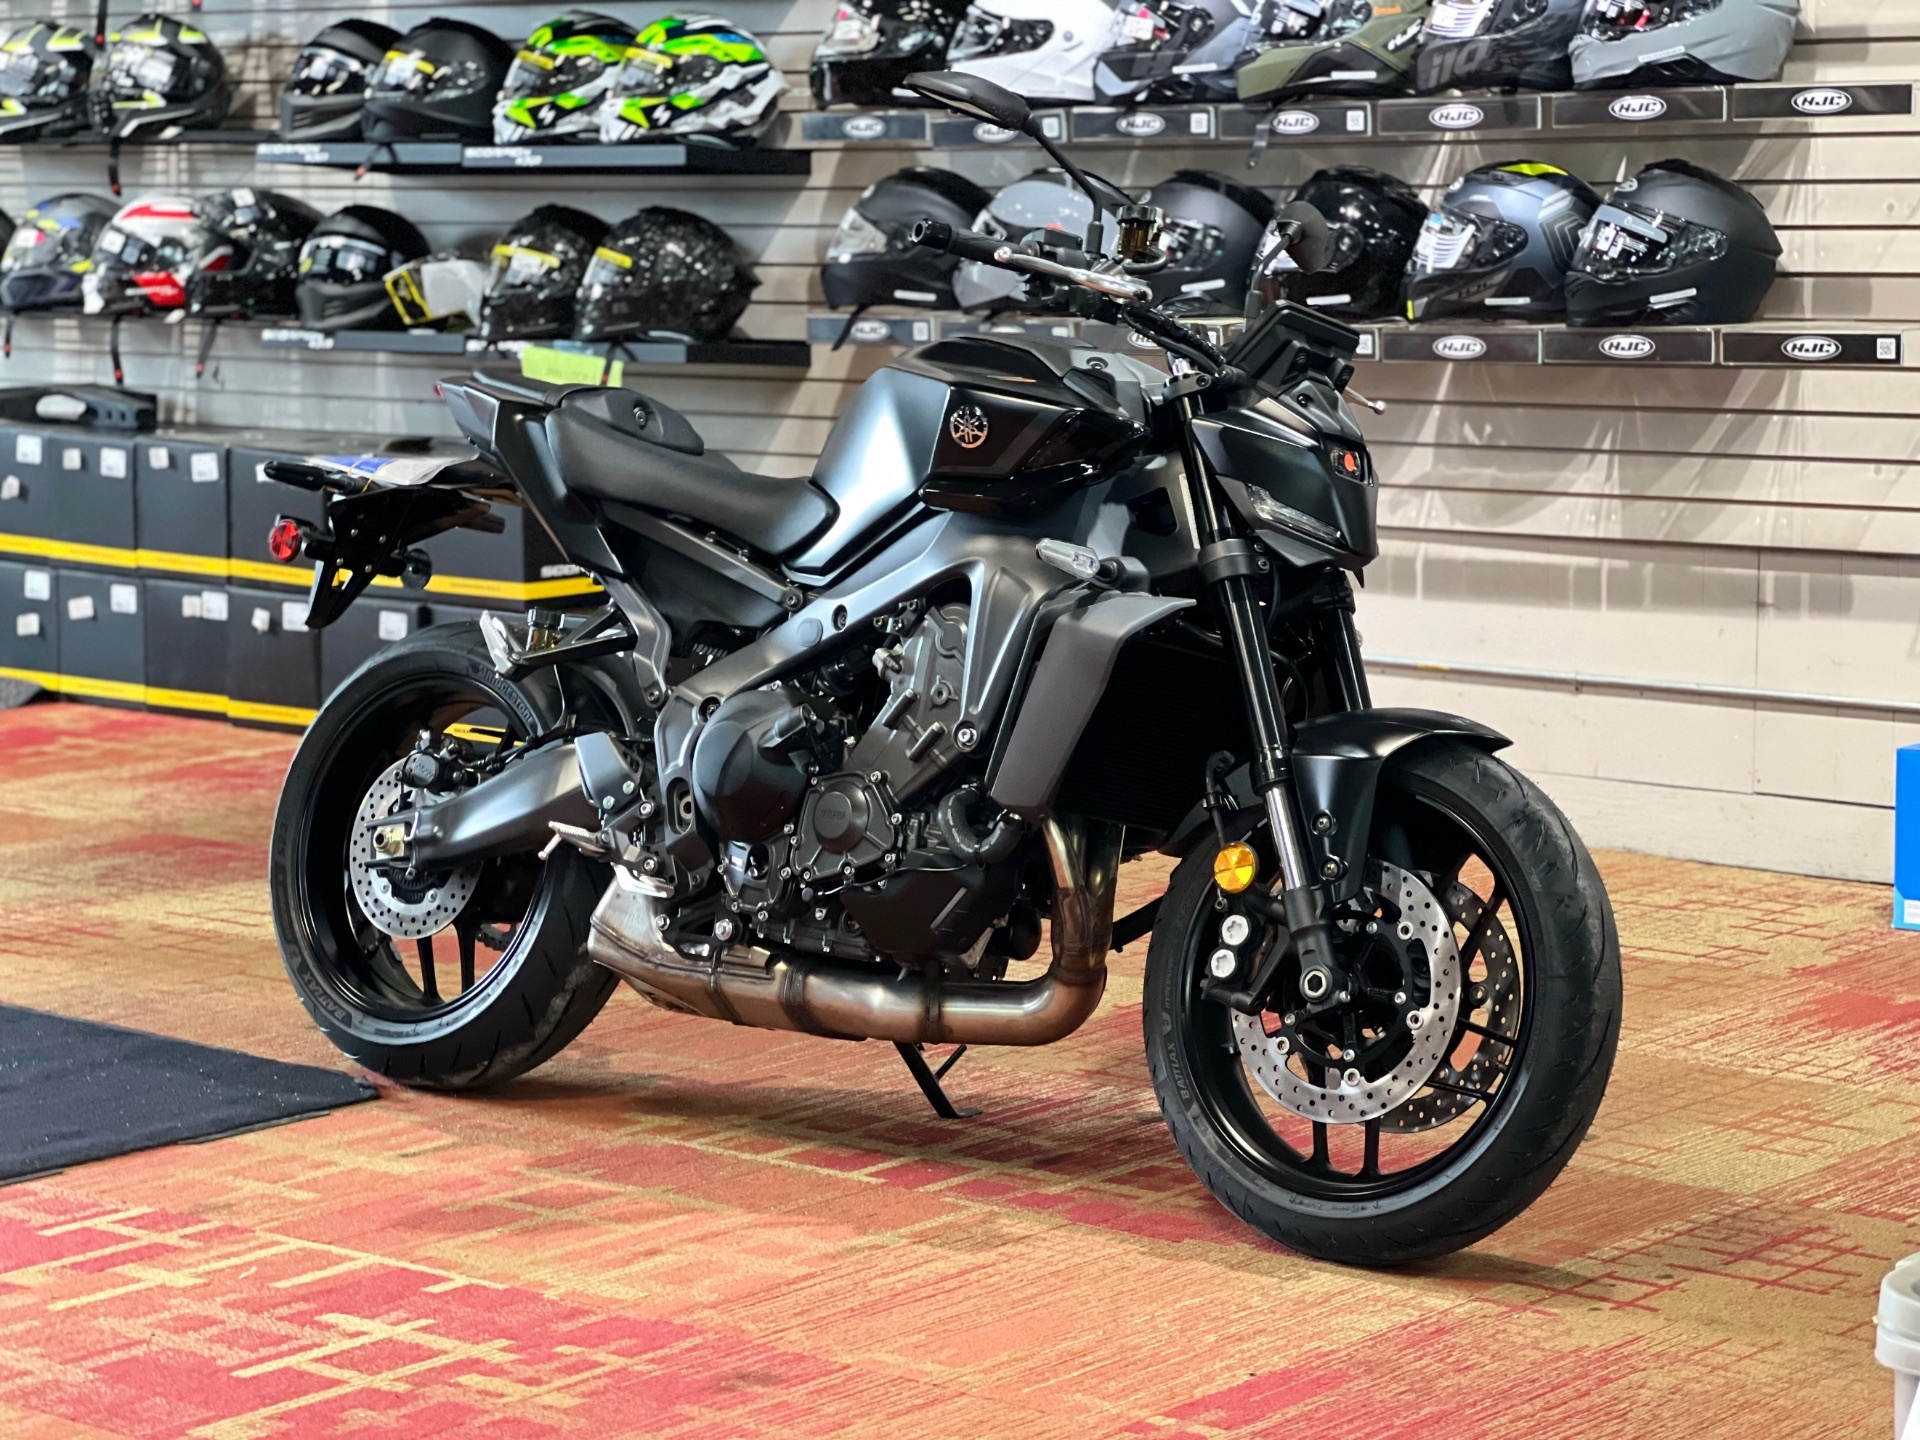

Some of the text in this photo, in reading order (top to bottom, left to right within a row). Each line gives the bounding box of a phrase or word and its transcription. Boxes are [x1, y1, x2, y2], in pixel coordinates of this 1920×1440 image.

[1801, 96, 1842, 106] HJC
[1618, 102, 1657, 113] HJC
[1438, 111, 1475, 121] HJC
[1276, 117, 1312, 128] HJC
[1442, 342, 1478, 352] HJC
[1607, 342, 1646, 352] HJC
[1790, 343, 1833, 353] HJC
[302, 973, 347, 1021] BATTLAX
[1167, 1042, 1190, 1100] BATTLAX
